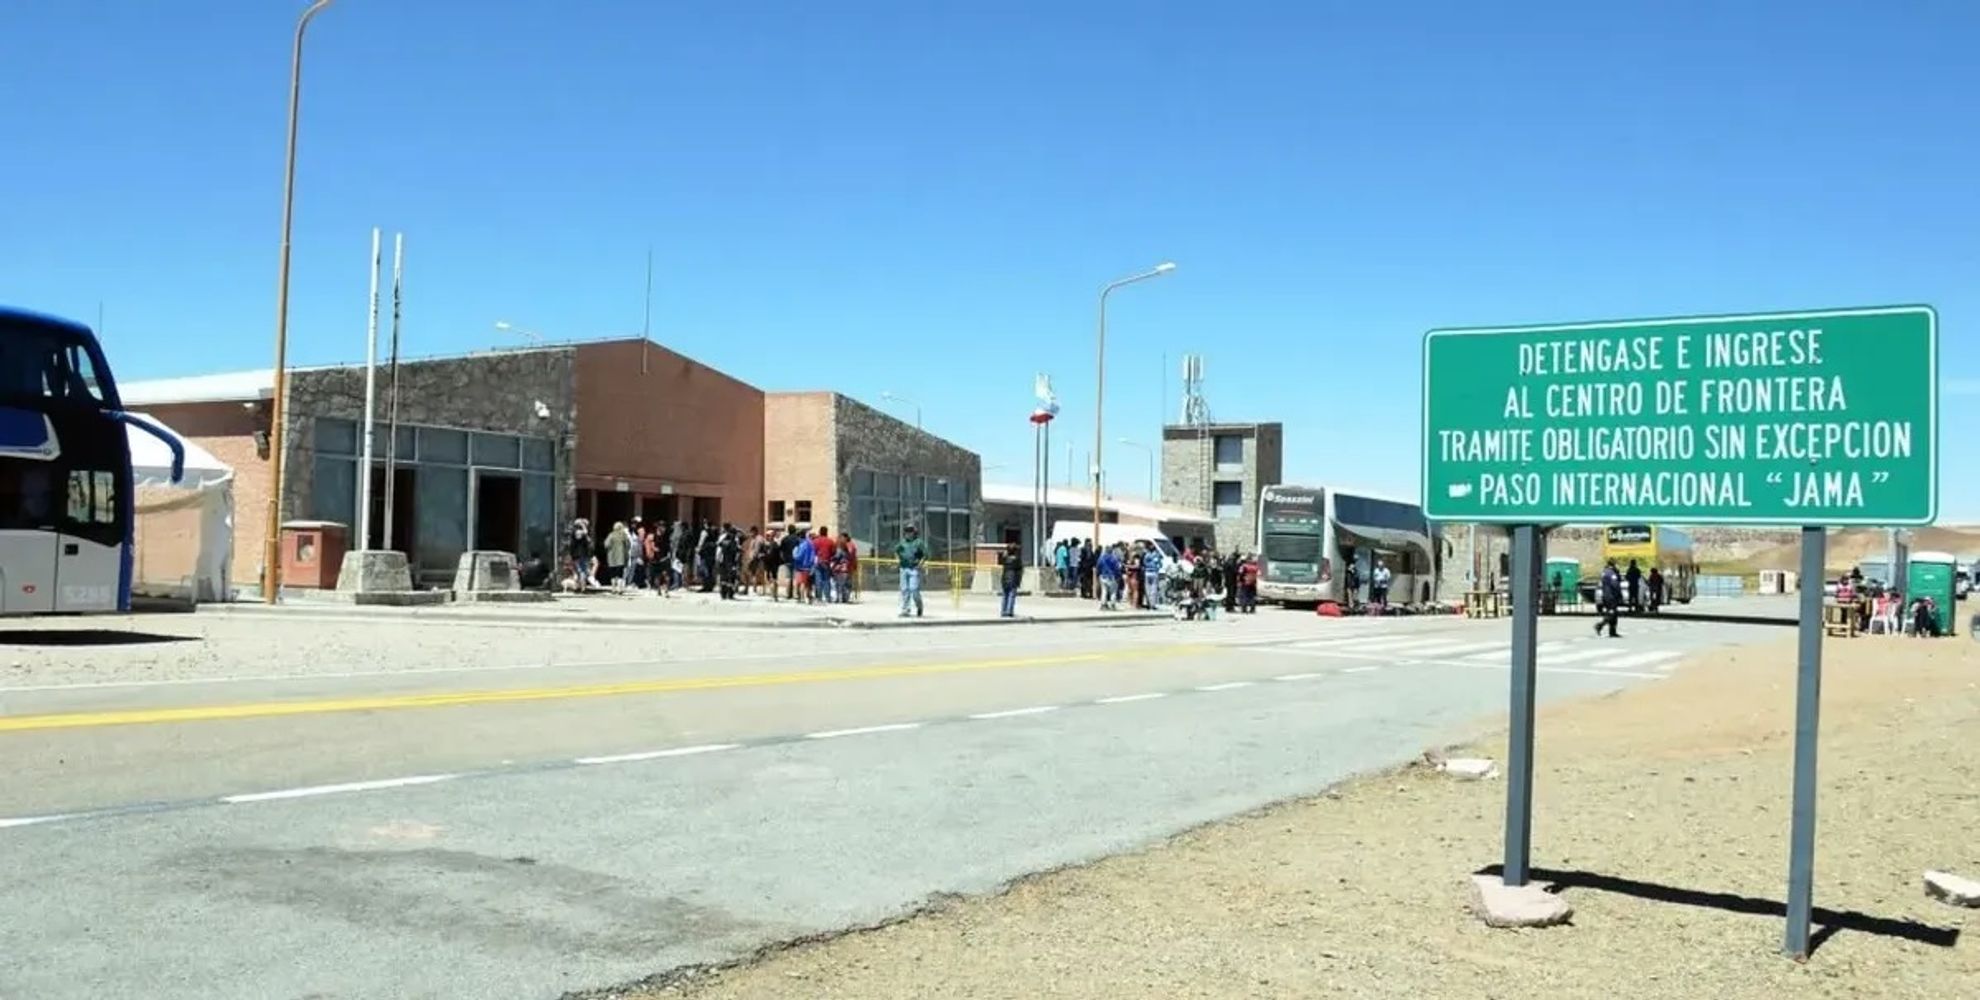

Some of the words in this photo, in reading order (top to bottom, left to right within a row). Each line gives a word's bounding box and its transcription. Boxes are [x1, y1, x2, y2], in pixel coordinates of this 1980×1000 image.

[1519, 336, 1663, 375] DETENGASE
[1677, 335, 1691, 369] E
[1706, 329, 1822, 368] INGRESE
[1504, 387, 1533, 418] AL
[1546, 381, 1643, 417] CENTRO
[1656, 380, 1687, 414] DE
[1701, 376, 1846, 413] FRONTERA
[1439, 429, 1533, 462] TRAMITE
[1542, 425, 1694, 461] OBLIGATORIO
[1705, 424, 1746, 459] SIN
[1756, 421, 1911, 460] EXCEPCION
[1480, 472, 1541, 506] PASO
[1552, 471, 1752, 507] INTERNACIONAL
